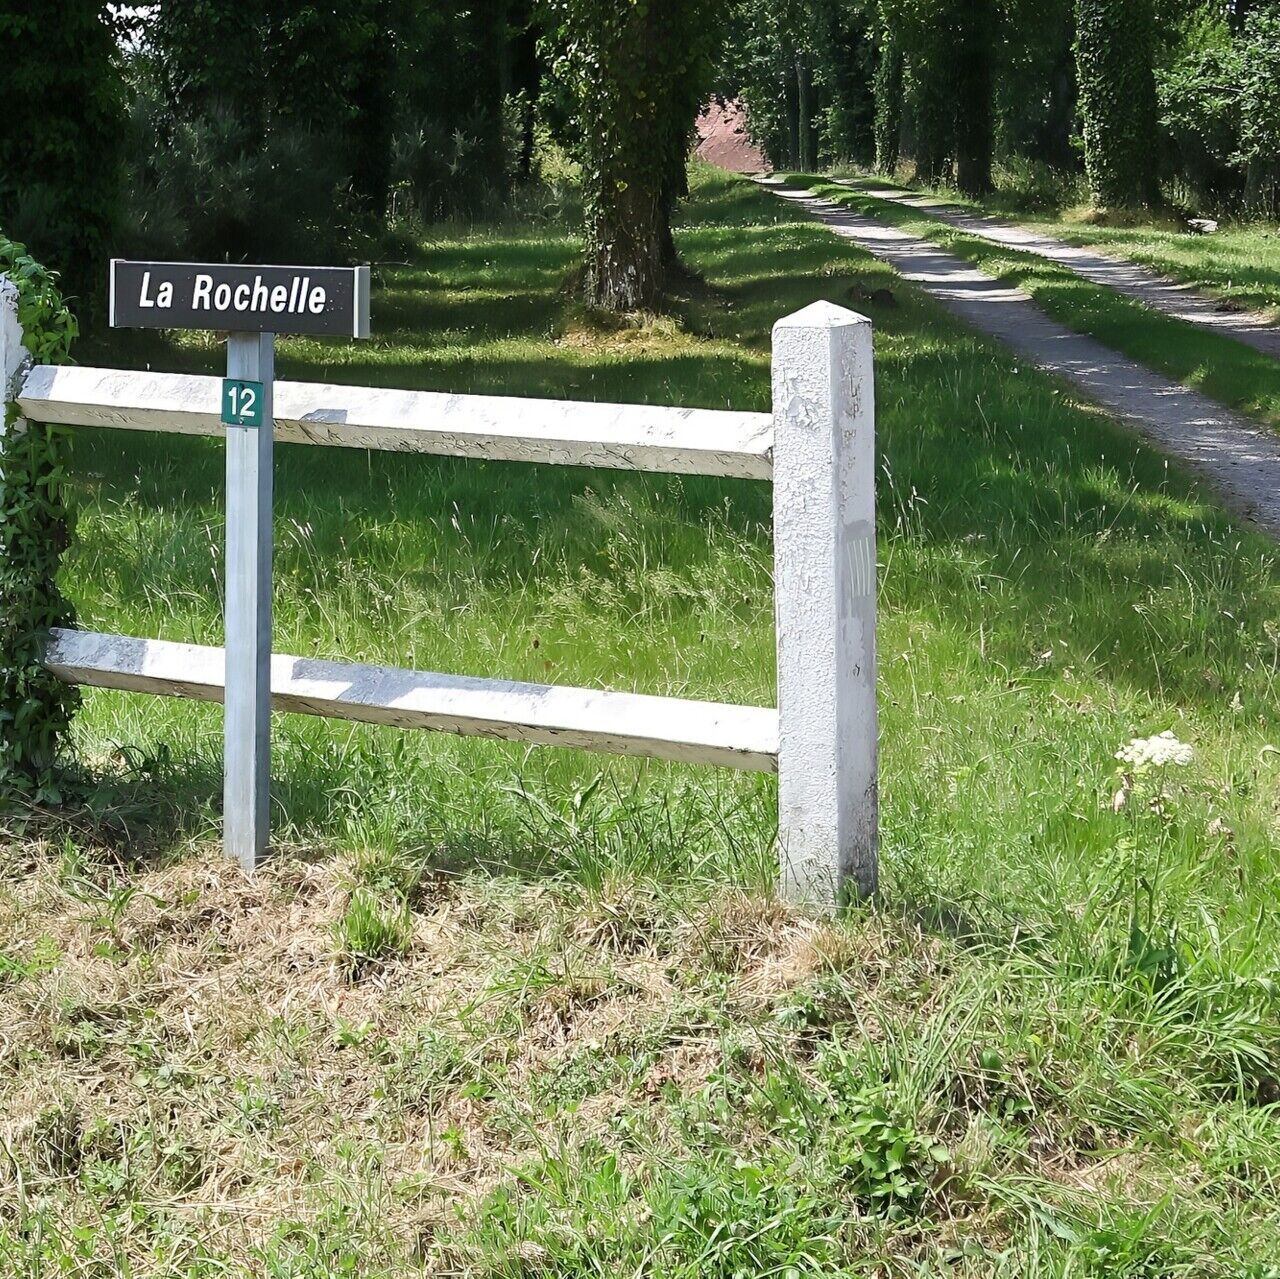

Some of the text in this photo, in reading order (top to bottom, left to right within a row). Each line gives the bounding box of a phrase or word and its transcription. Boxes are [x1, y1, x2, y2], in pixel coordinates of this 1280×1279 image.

[139, 271, 326, 314] La Rochelle
[228, 386, 256, 417] 12
